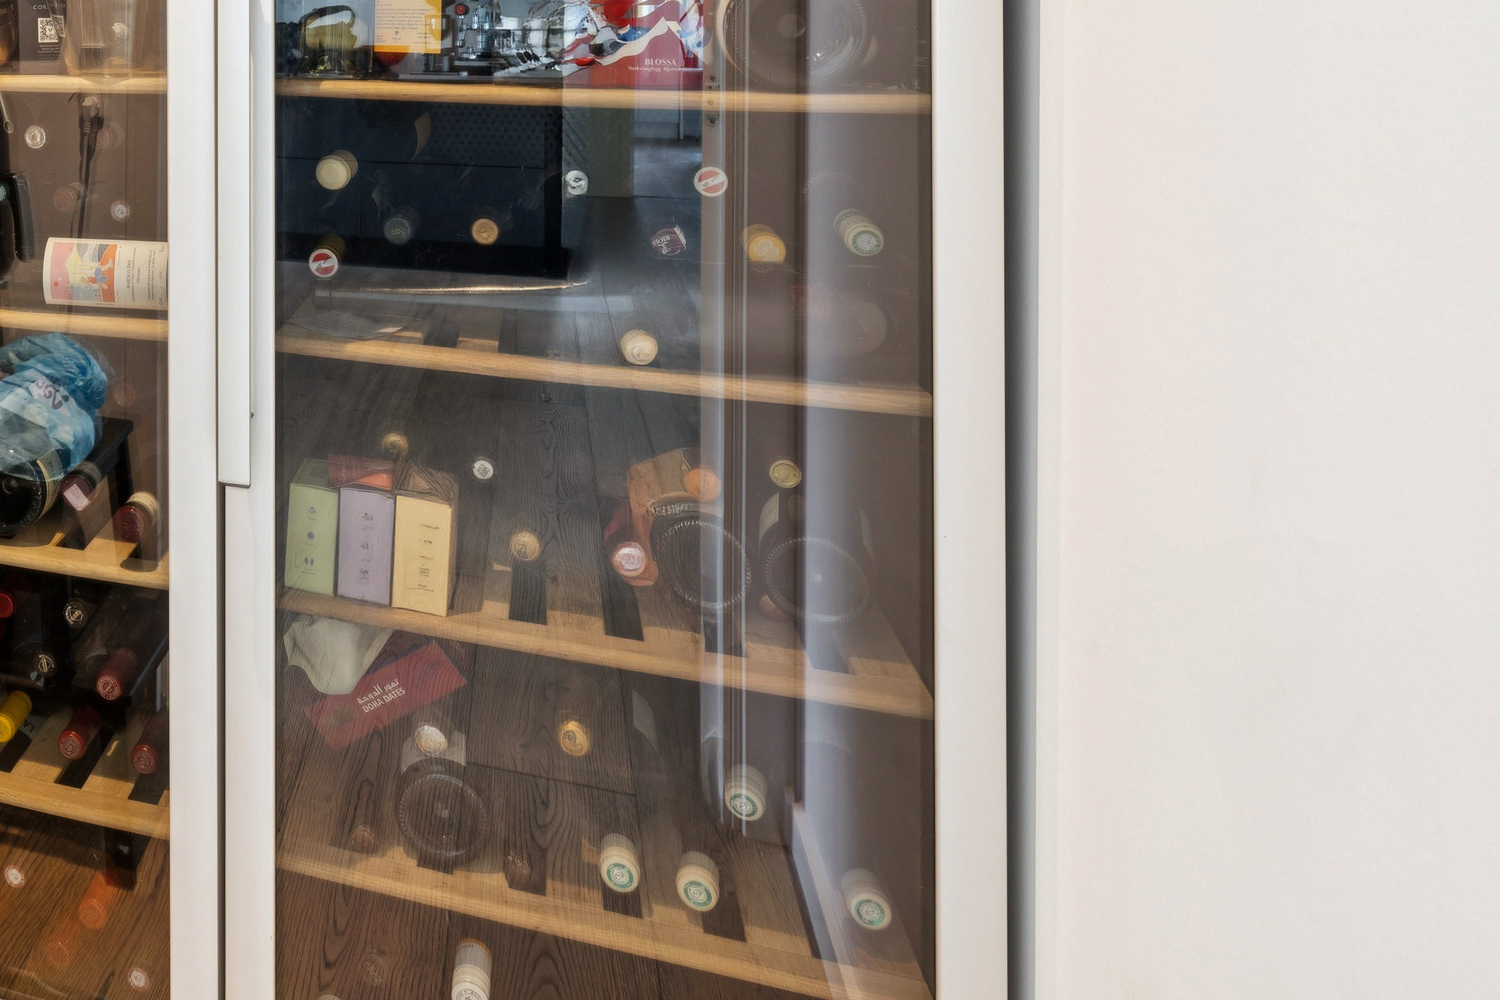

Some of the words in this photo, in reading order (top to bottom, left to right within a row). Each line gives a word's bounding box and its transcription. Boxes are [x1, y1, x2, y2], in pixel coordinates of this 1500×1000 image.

[644, 58, 677, 66] BLOSSA
[357, 684, 383, 704] الدوحة
[362, 699, 384, 713] DOHA
[383, 687, 406, 702] DATES
